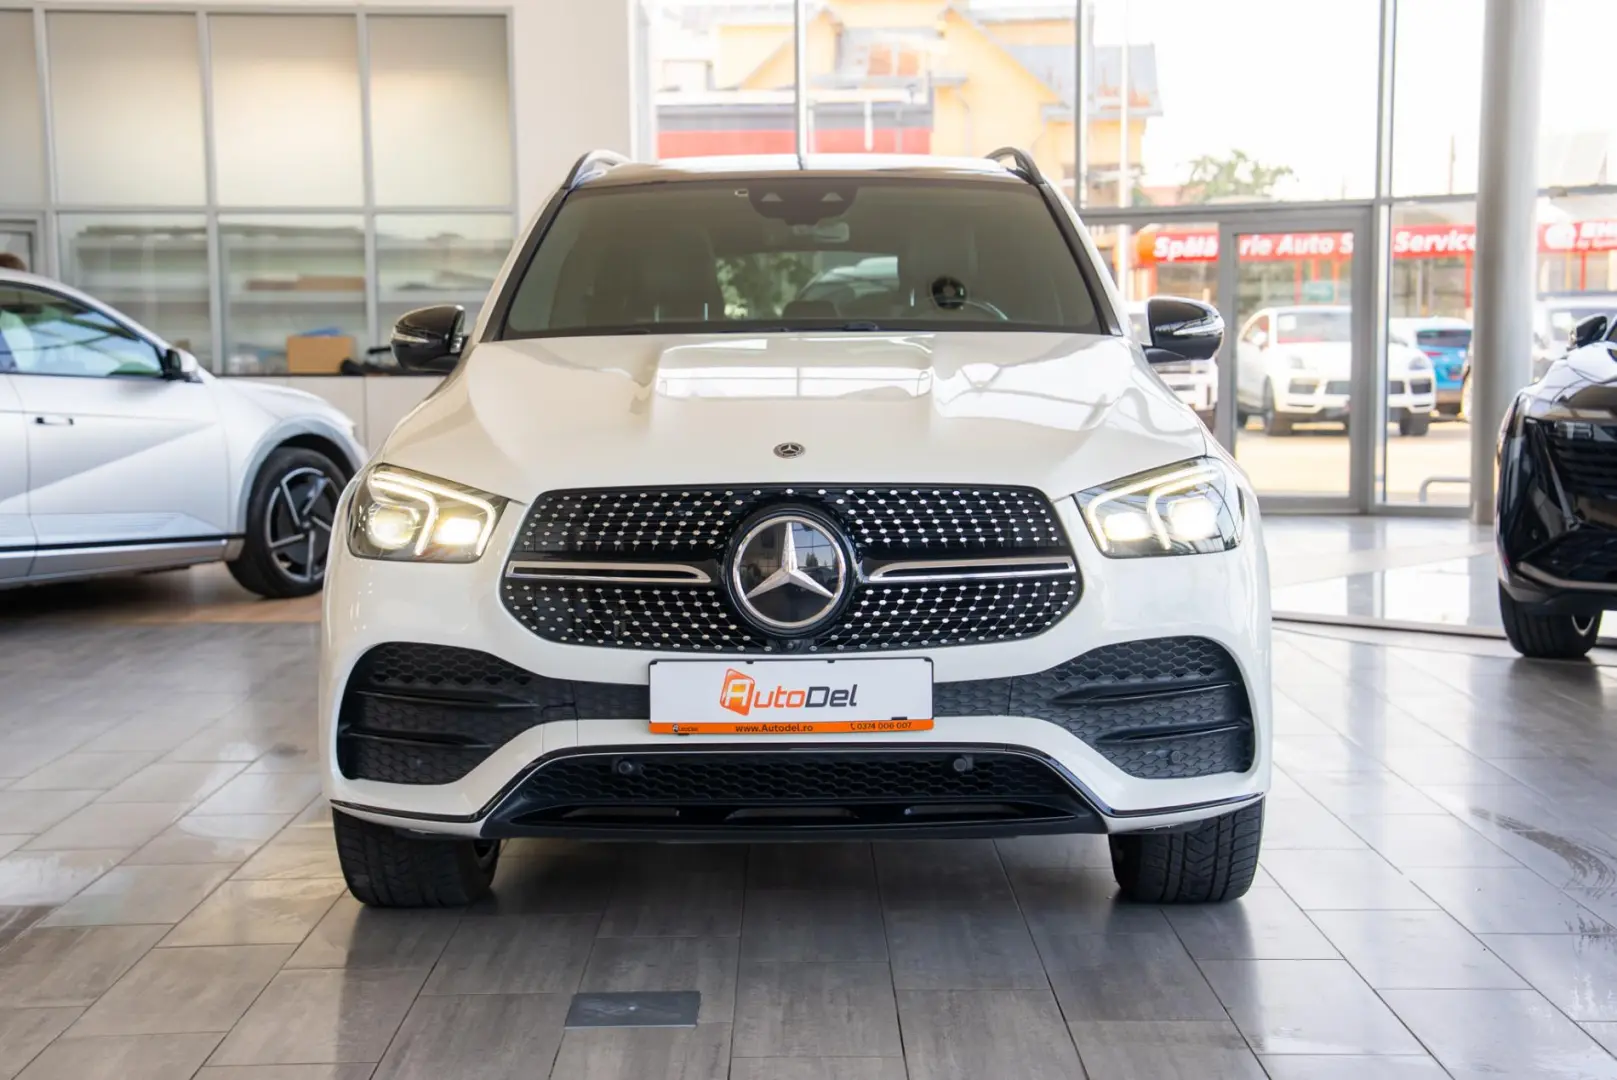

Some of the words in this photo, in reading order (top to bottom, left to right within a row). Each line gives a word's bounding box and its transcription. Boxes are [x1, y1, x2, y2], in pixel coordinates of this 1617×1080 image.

[1275, 233, 1334, 256] Auto
[721, 675, 858, 711] AutoDel
[735, 723, 814, 733] www.Autodel.ro
